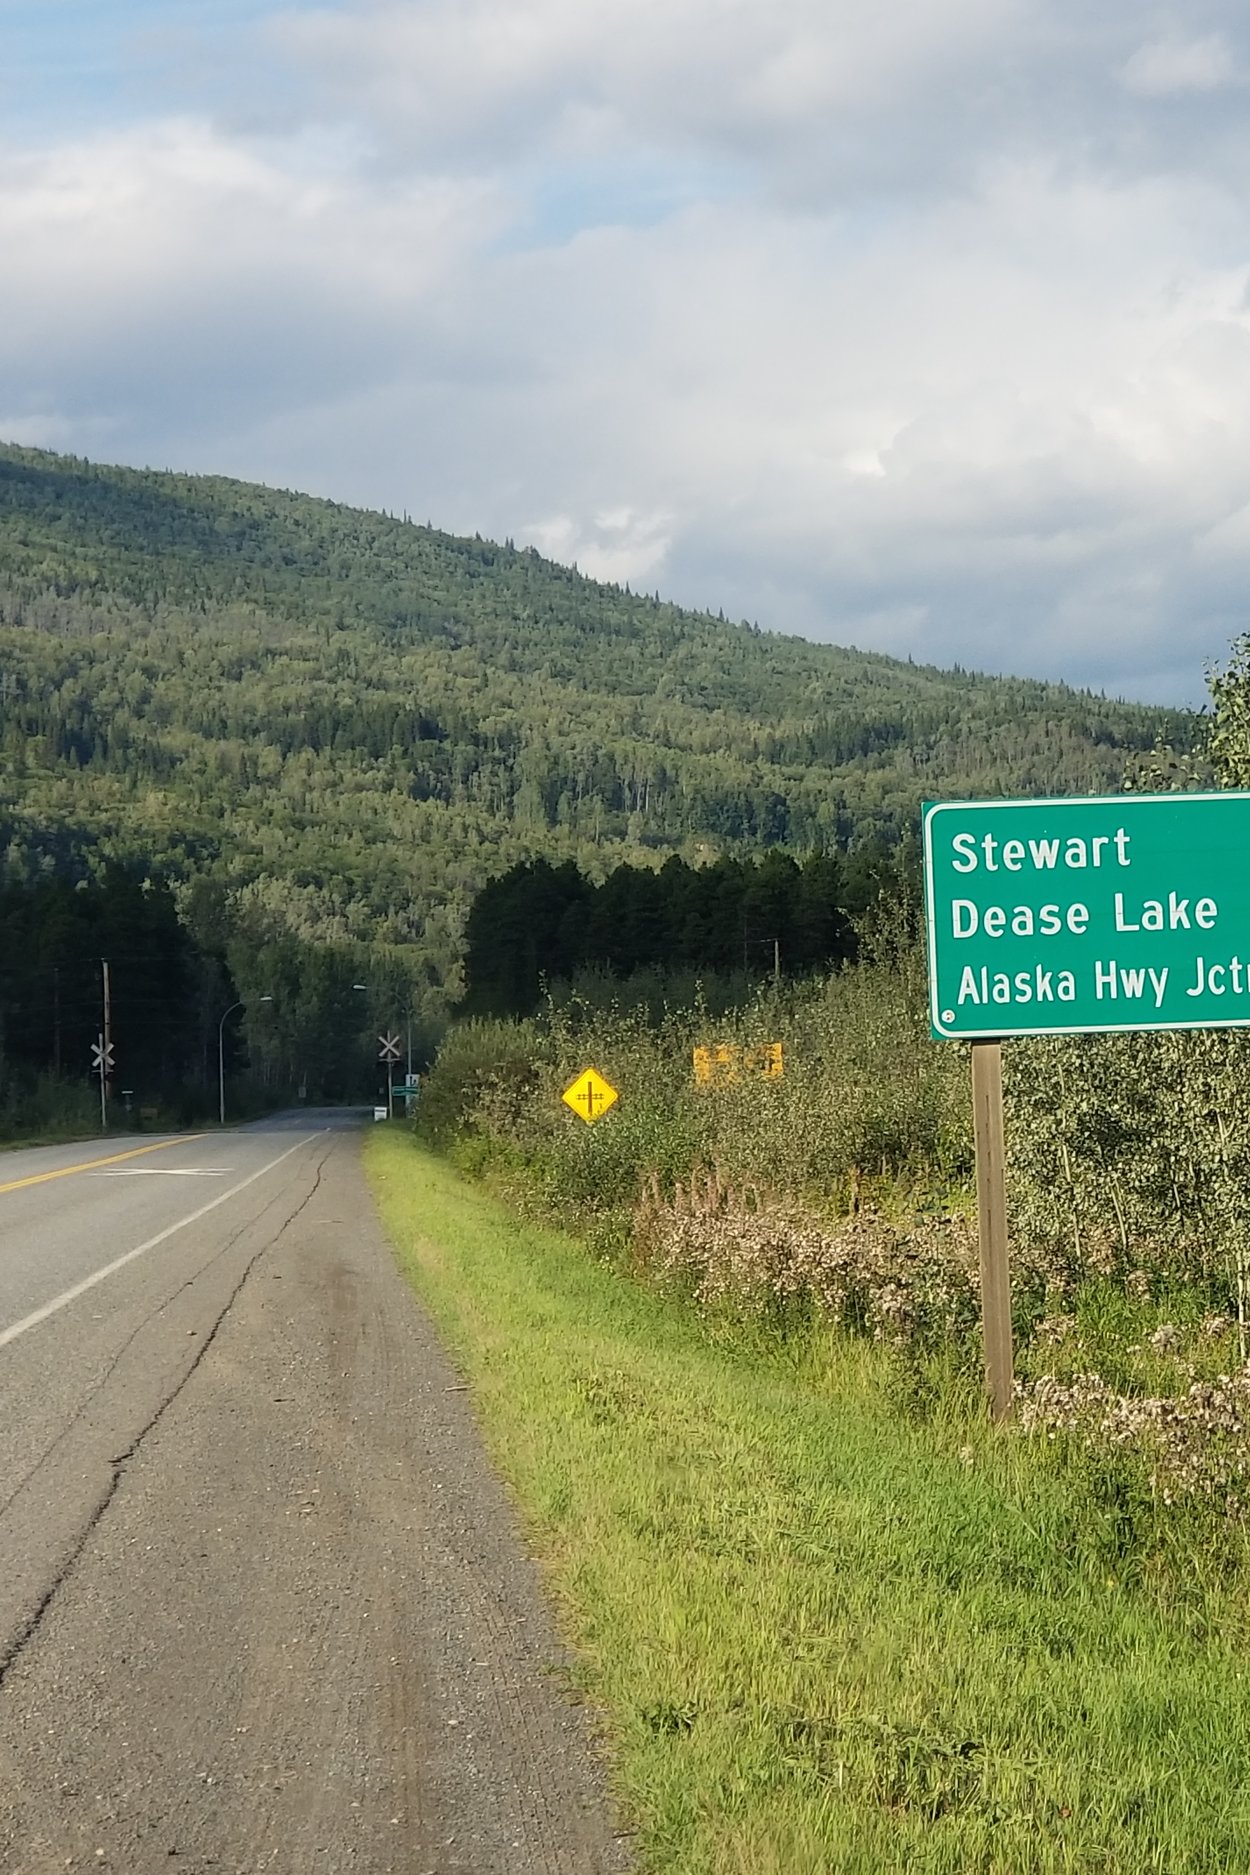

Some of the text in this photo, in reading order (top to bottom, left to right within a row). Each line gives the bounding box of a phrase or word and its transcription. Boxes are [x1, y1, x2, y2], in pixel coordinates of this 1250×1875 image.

[952, 828, 1131, 873] Stewart
[952, 891, 1218, 939] Dease Lake
[957, 964, 1076, 1005] Alaska
[1095, 960, 1169, 1008] Hwy
